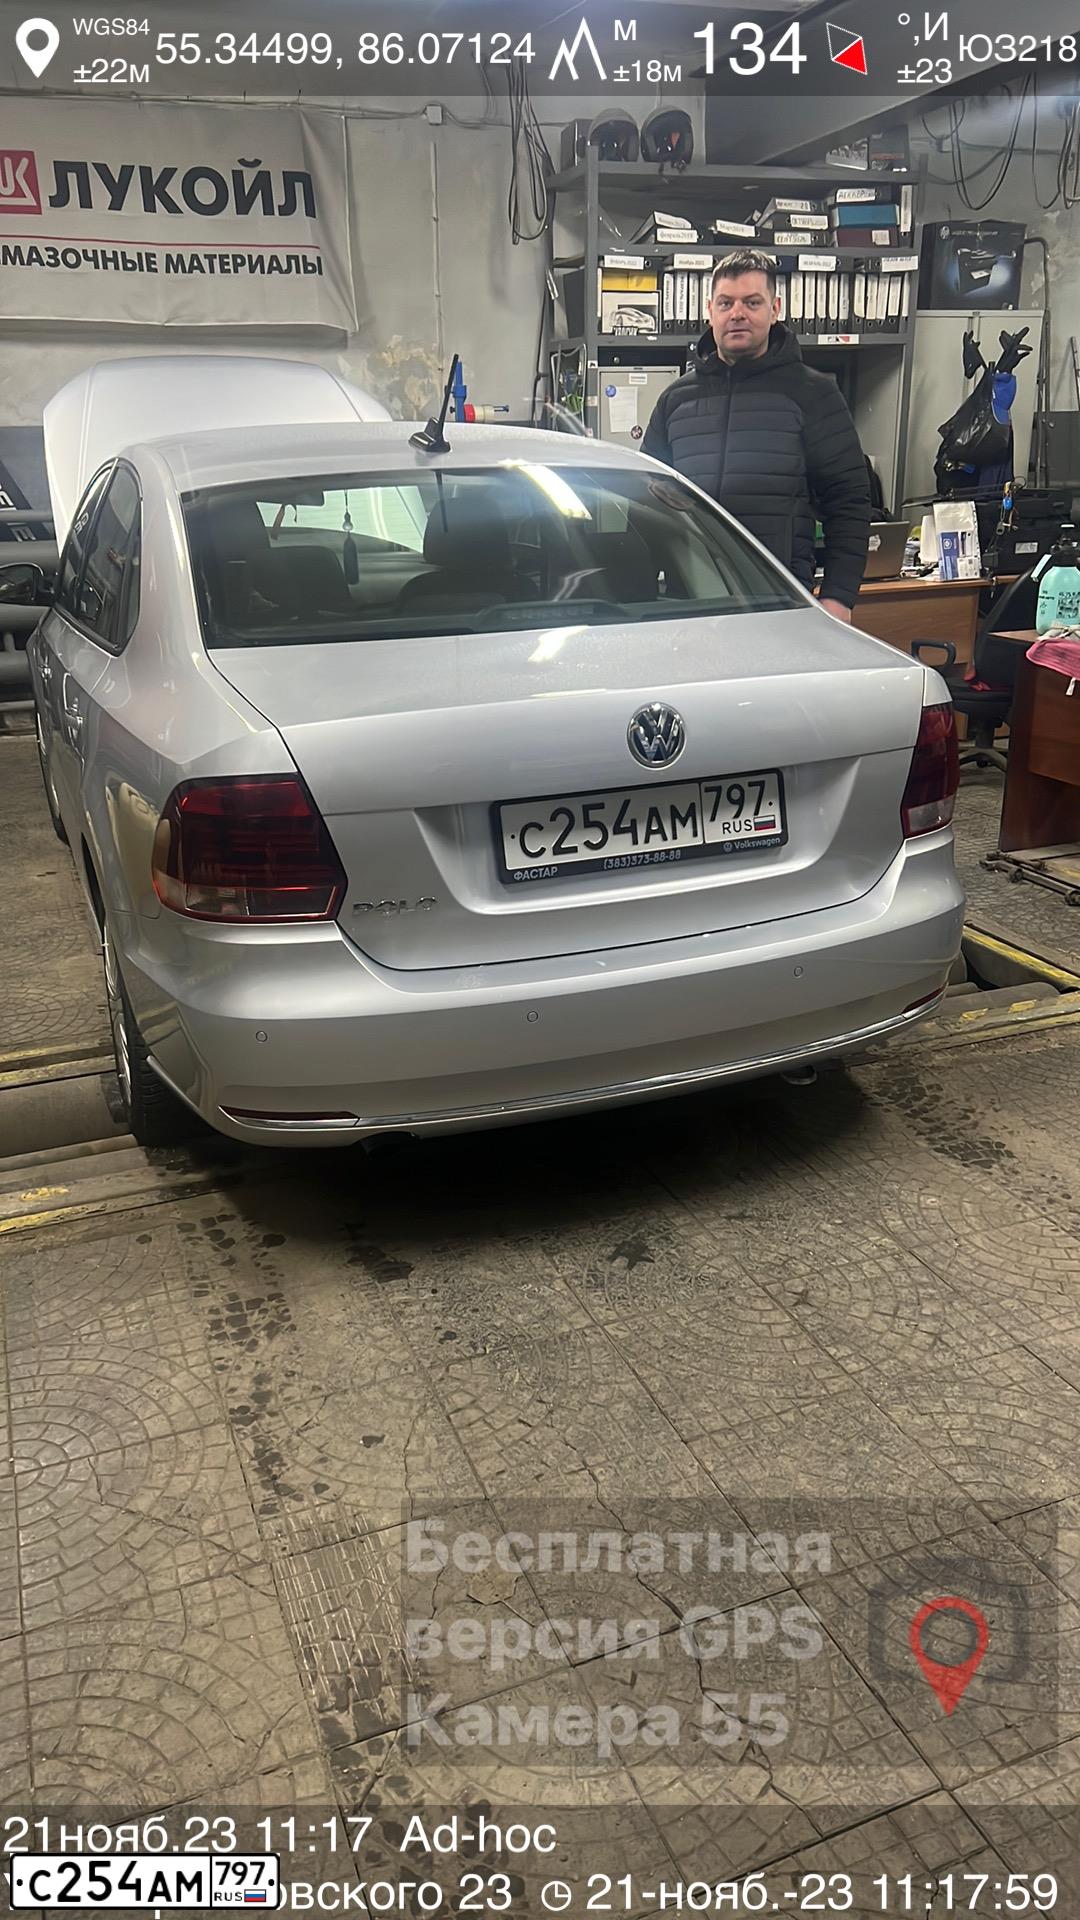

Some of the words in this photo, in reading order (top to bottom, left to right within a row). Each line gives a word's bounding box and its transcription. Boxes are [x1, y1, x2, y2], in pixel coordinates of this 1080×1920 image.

[48, 157, 317, 219] ЛУКОЙЛ
[0, 244, 158, 273] МАЗОЧНЫЕ
[164, 253, 323, 276] МАТЕРИАЛЫ
[703, 781, 767, 823] 797
[722, 819, 753, 835] RUS
[733, 837, 781, 850] Volkswagen
[603, 849, 682, 870] (383)373-88-88
[513, 866, 559, 881] ФАСТАР
[352, 896, 438, 917] POLO
